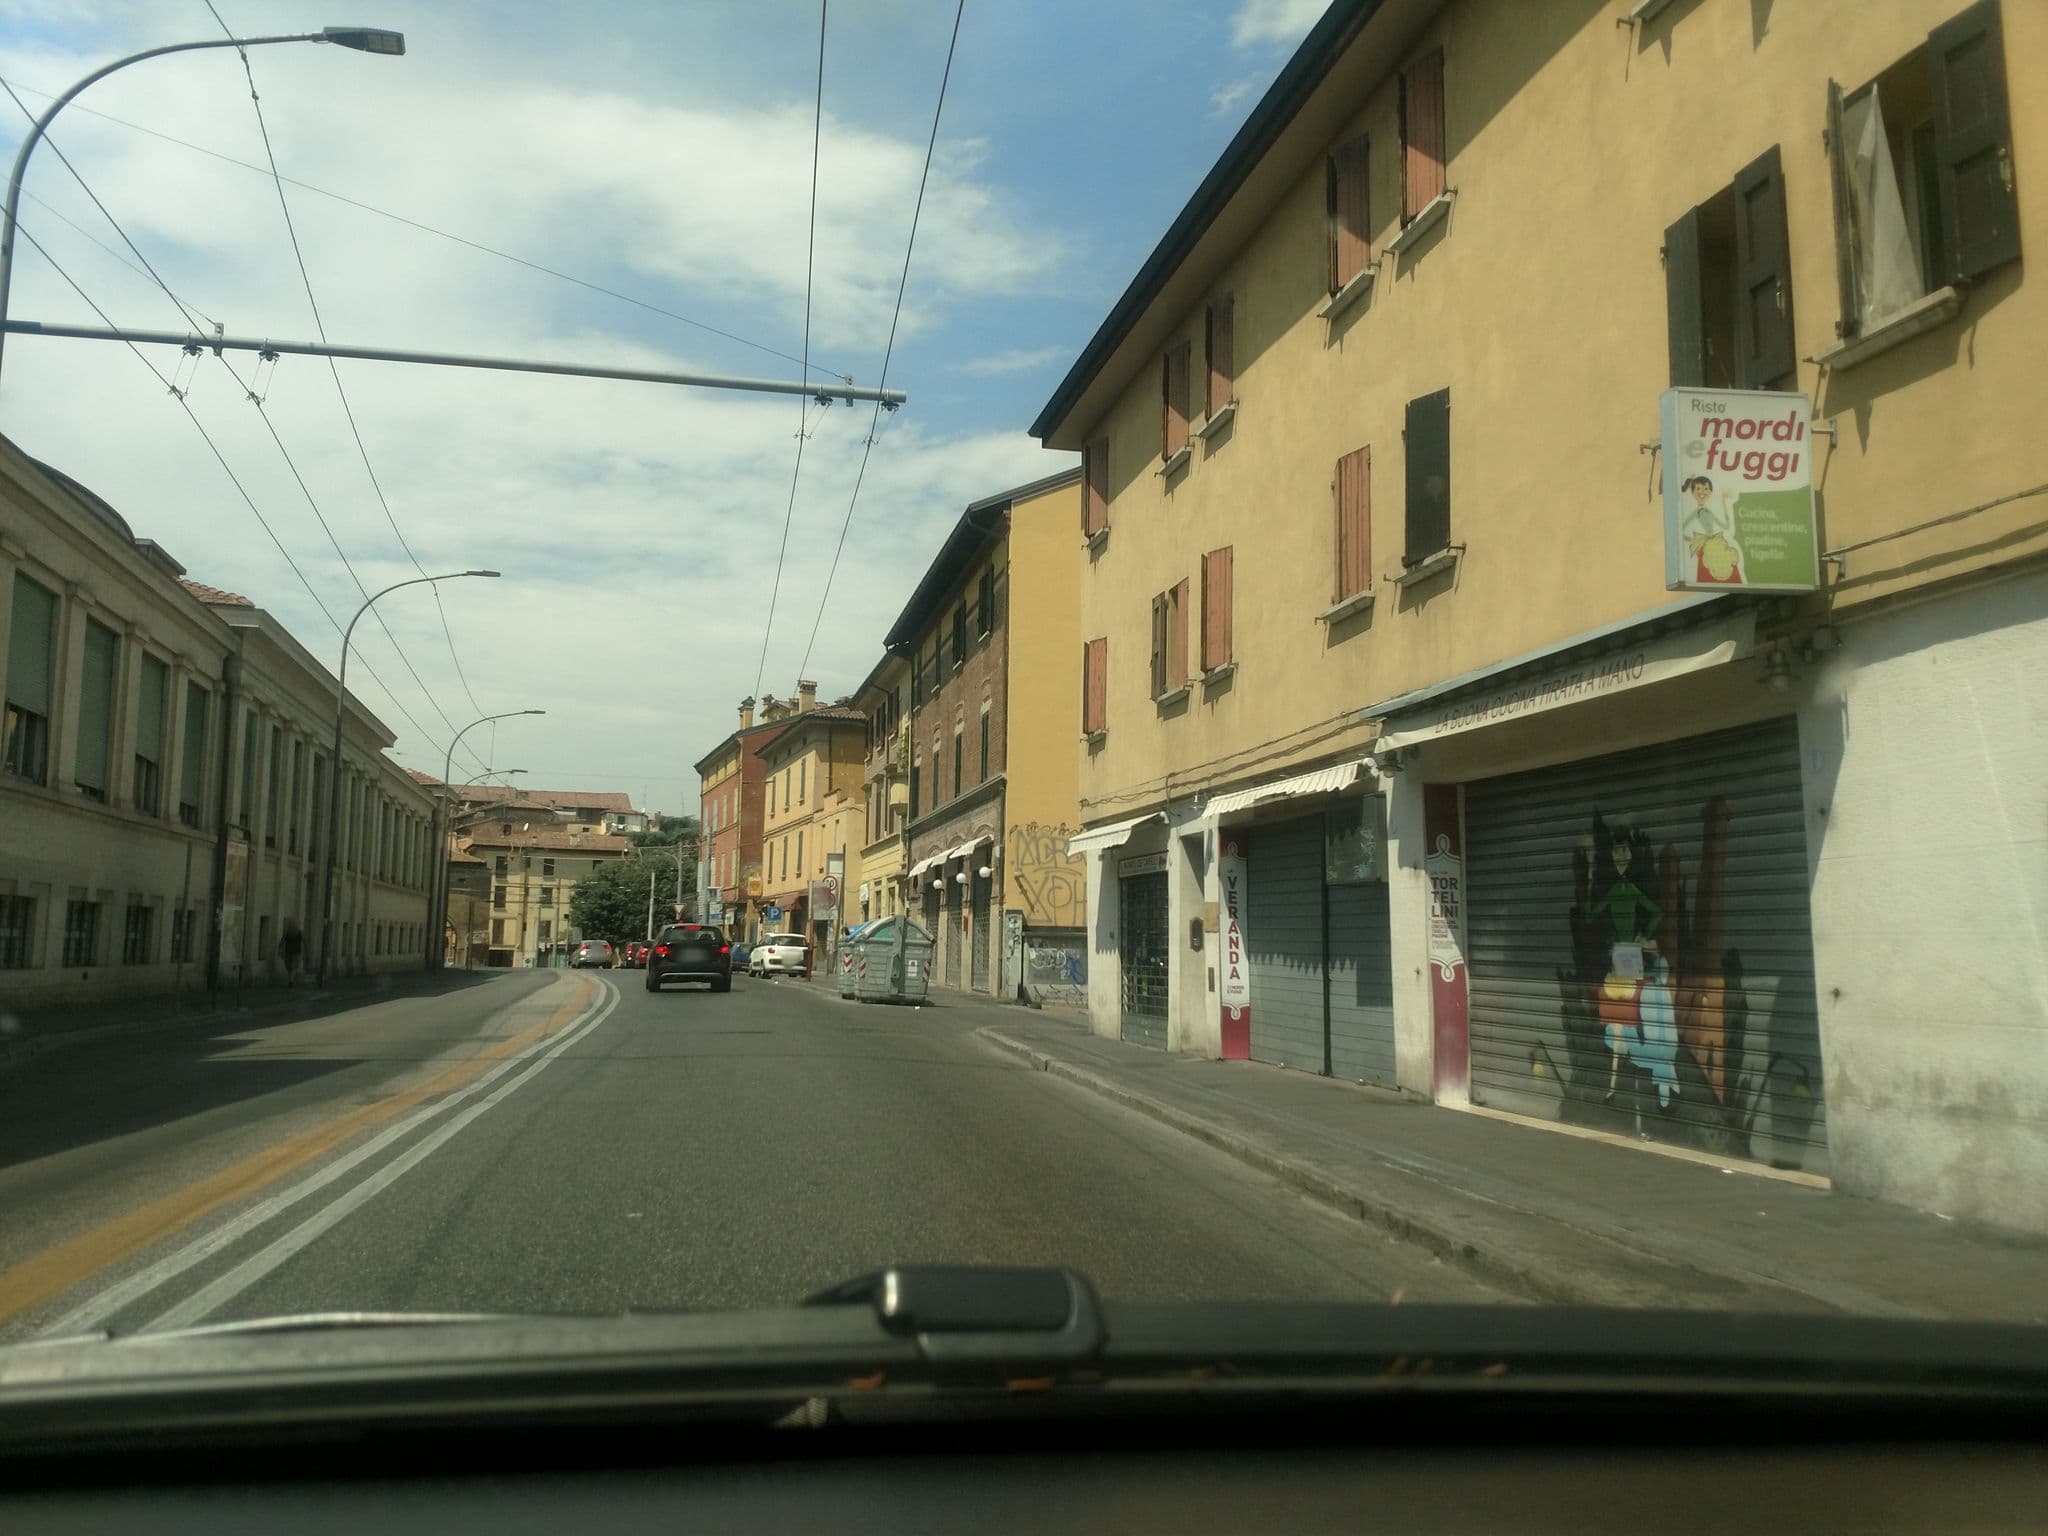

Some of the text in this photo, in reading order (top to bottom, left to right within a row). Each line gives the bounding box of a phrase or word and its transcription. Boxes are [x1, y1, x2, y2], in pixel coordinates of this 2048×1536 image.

[1700, 410, 1805, 442] mordi
[1706, 439, 1800, 481] fuggi
[1434, 652, 1645, 734] LA BUONA CUCINA TIRATA A MANO
[1431, 876, 1458, 890] TOR
[1431, 891, 1459, 904] TEL
[1431, 905, 1458, 918] LINI
[1226, 876, 1241, 981] VERANDA
